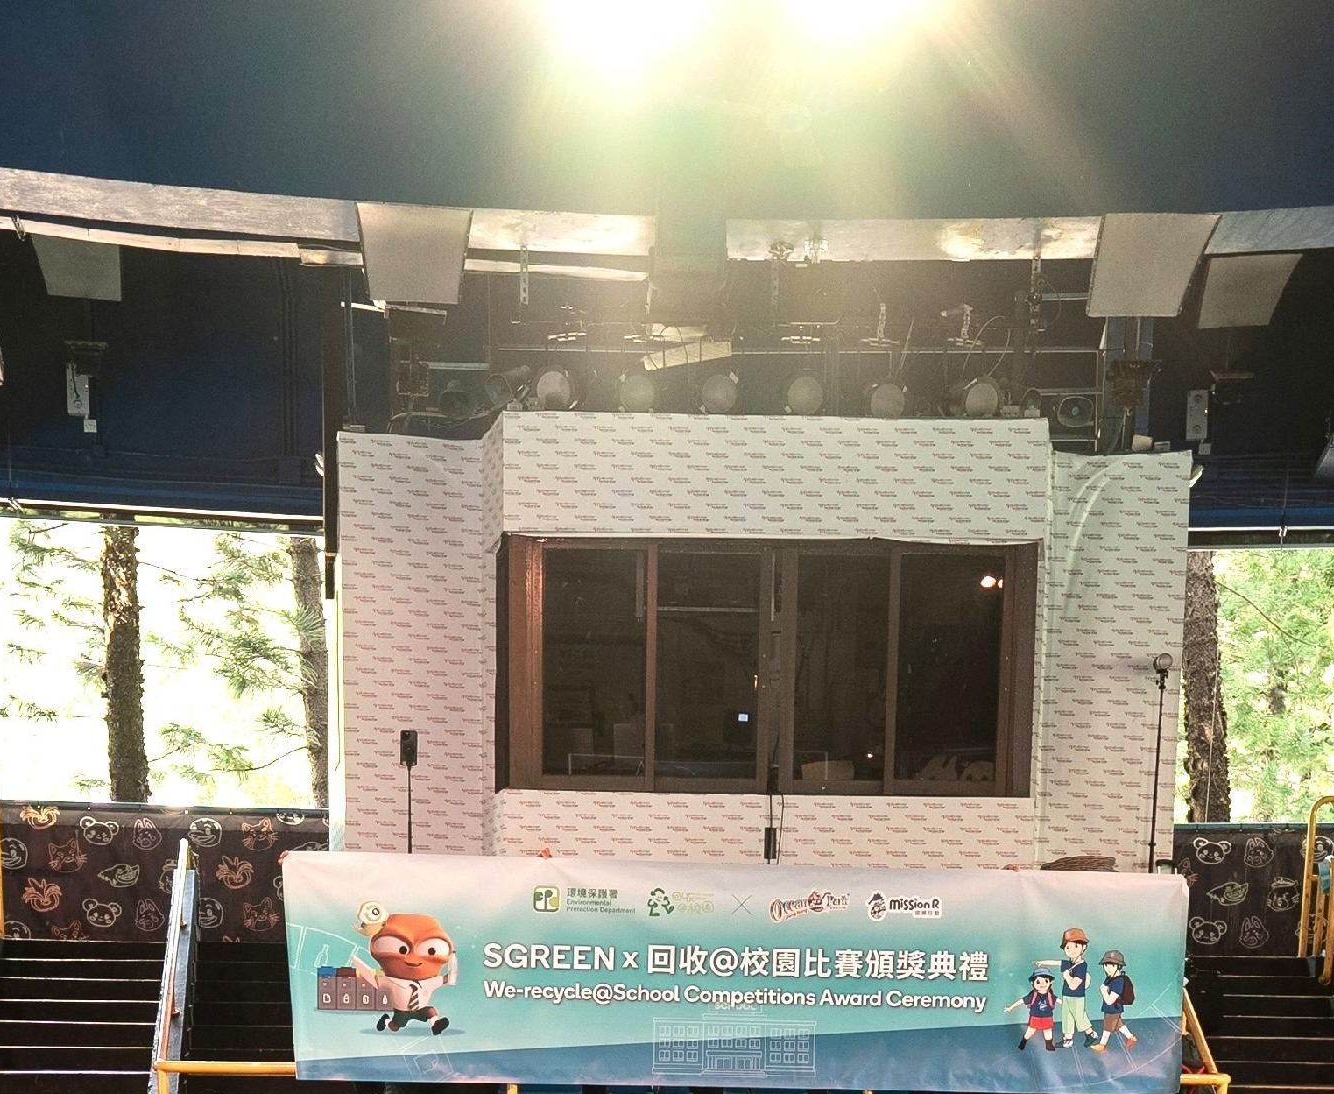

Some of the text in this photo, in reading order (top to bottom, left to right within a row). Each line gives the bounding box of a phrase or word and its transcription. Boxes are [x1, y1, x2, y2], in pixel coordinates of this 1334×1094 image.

[566, 887, 618, 899] 環境保護署
[566, 899, 612, 907] Environmental
[931, 899, 940, 909] R
[599, 906, 636, 915] Department
[483, 942, 989, 981] SGREEN x 回收@校園比賽頒獎典禮
[483, 981, 987, 1013] We-recycle@School Competitions Award Ceremony
